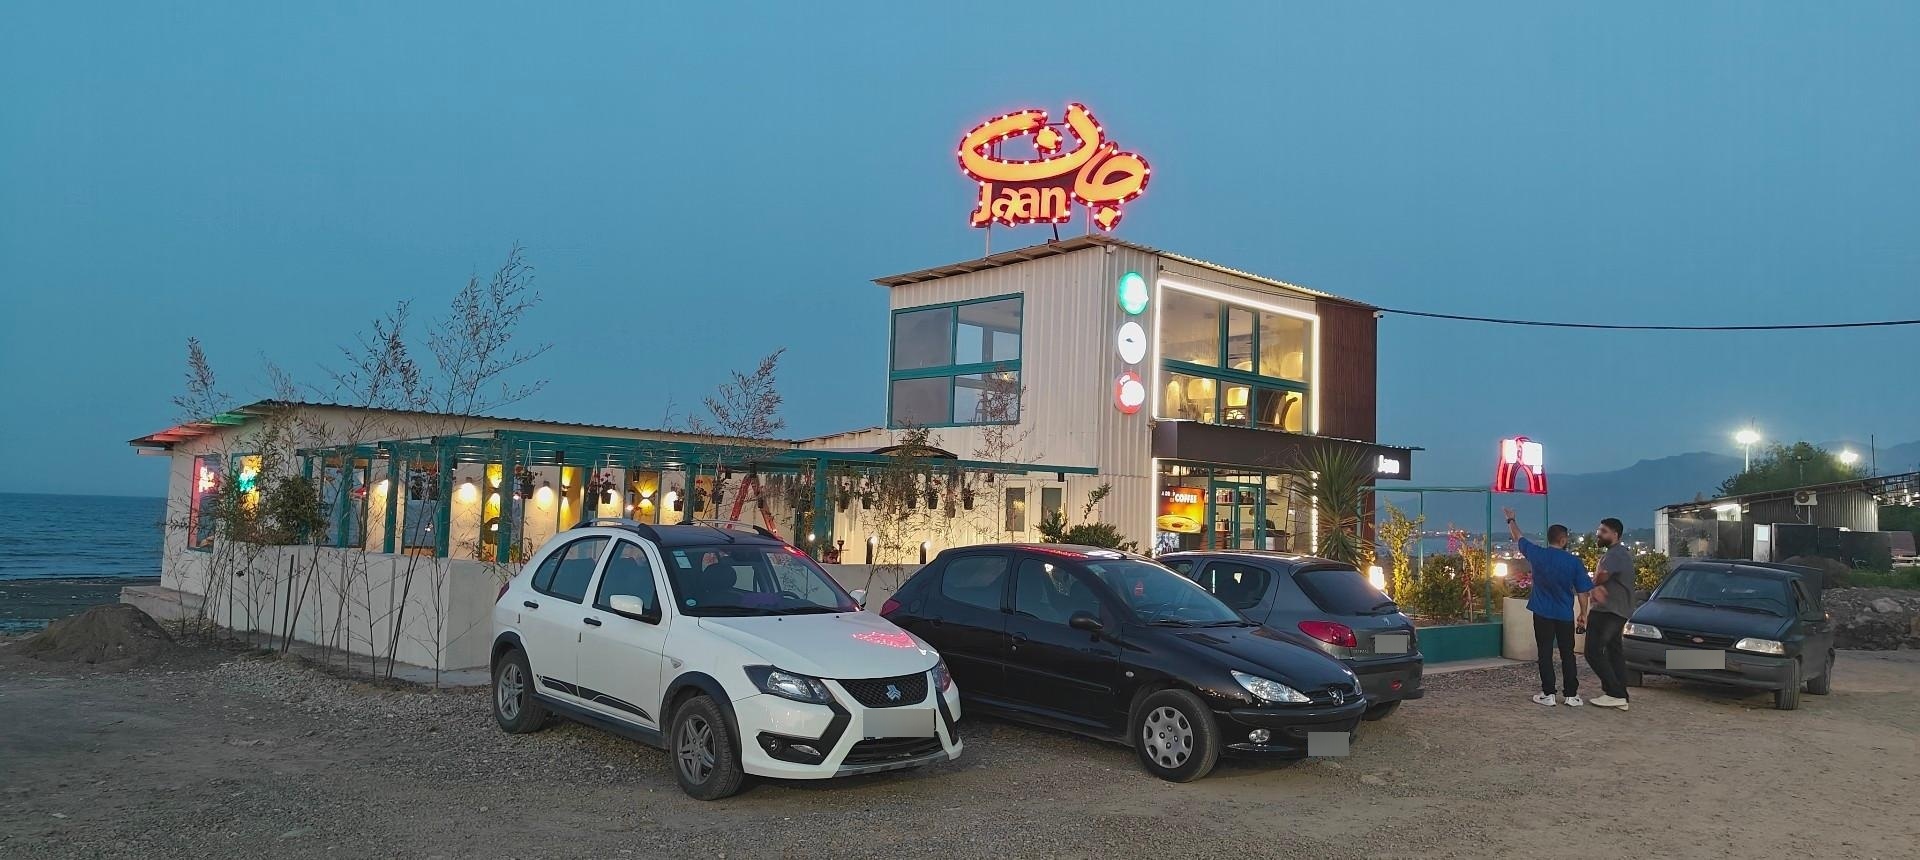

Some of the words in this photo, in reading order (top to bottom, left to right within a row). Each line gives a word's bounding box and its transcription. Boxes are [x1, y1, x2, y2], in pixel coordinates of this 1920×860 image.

[960, 104, 1149, 230] جان
[973, 182, 1067, 224] Jaan
[1175, 493, 1197, 503] COFFEE
